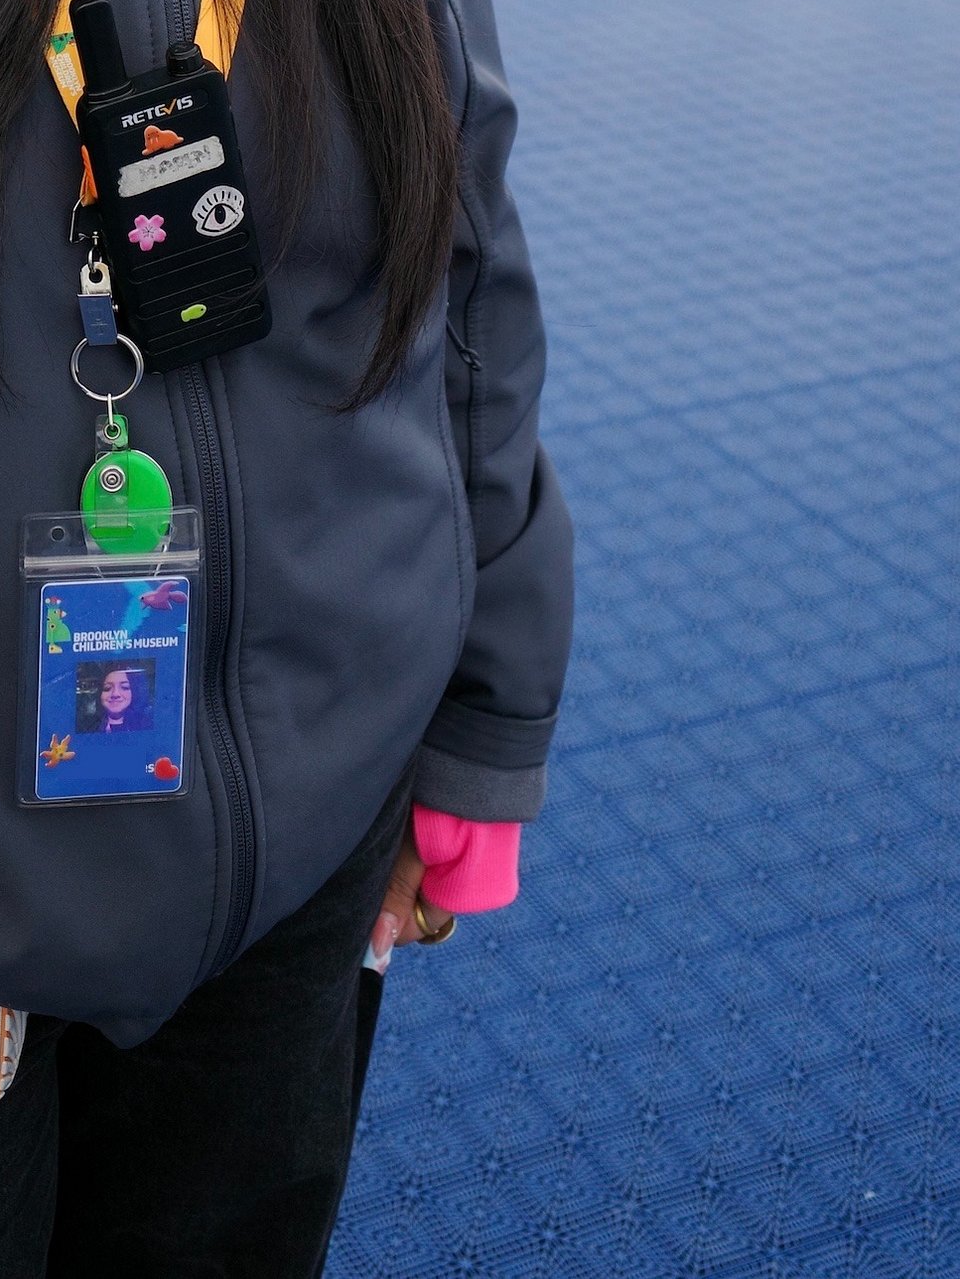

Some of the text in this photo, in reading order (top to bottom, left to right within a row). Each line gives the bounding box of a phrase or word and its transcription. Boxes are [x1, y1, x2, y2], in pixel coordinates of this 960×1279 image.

[121, 95, 194, 128] RETEVIS
[73, 630, 128, 642] BROOKLYN
[72, 637, 179, 652] CHILDREN'S MUSEUM
